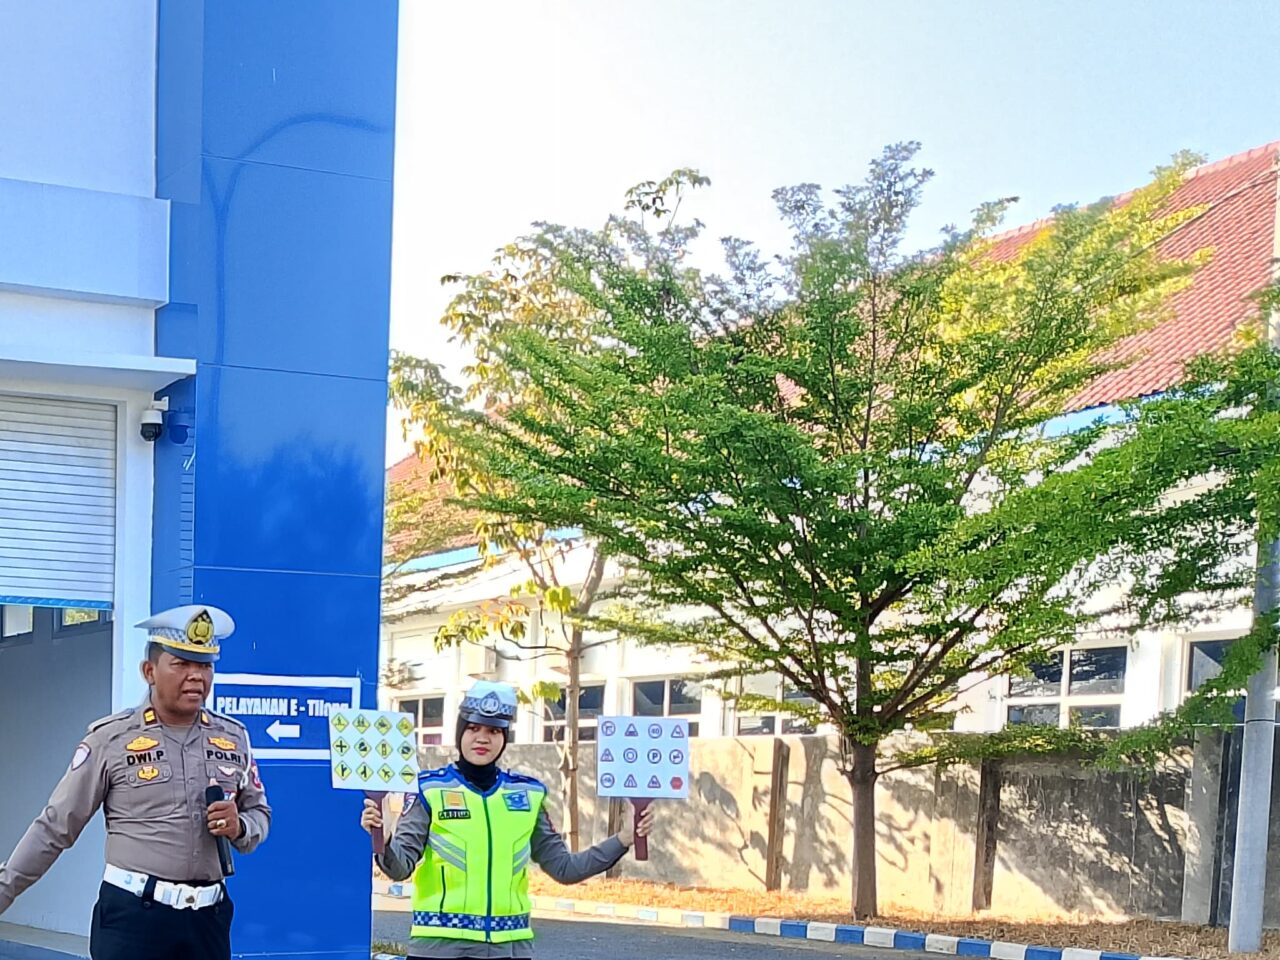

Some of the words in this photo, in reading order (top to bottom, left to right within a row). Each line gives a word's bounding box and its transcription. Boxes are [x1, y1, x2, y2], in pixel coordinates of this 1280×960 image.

[217, 697, 288, 716] PELAYANAN
[290, 699, 298, 716] E
[126, 750, 164, 765] DWI.P
[206, 750, 241, 763] POLRI
